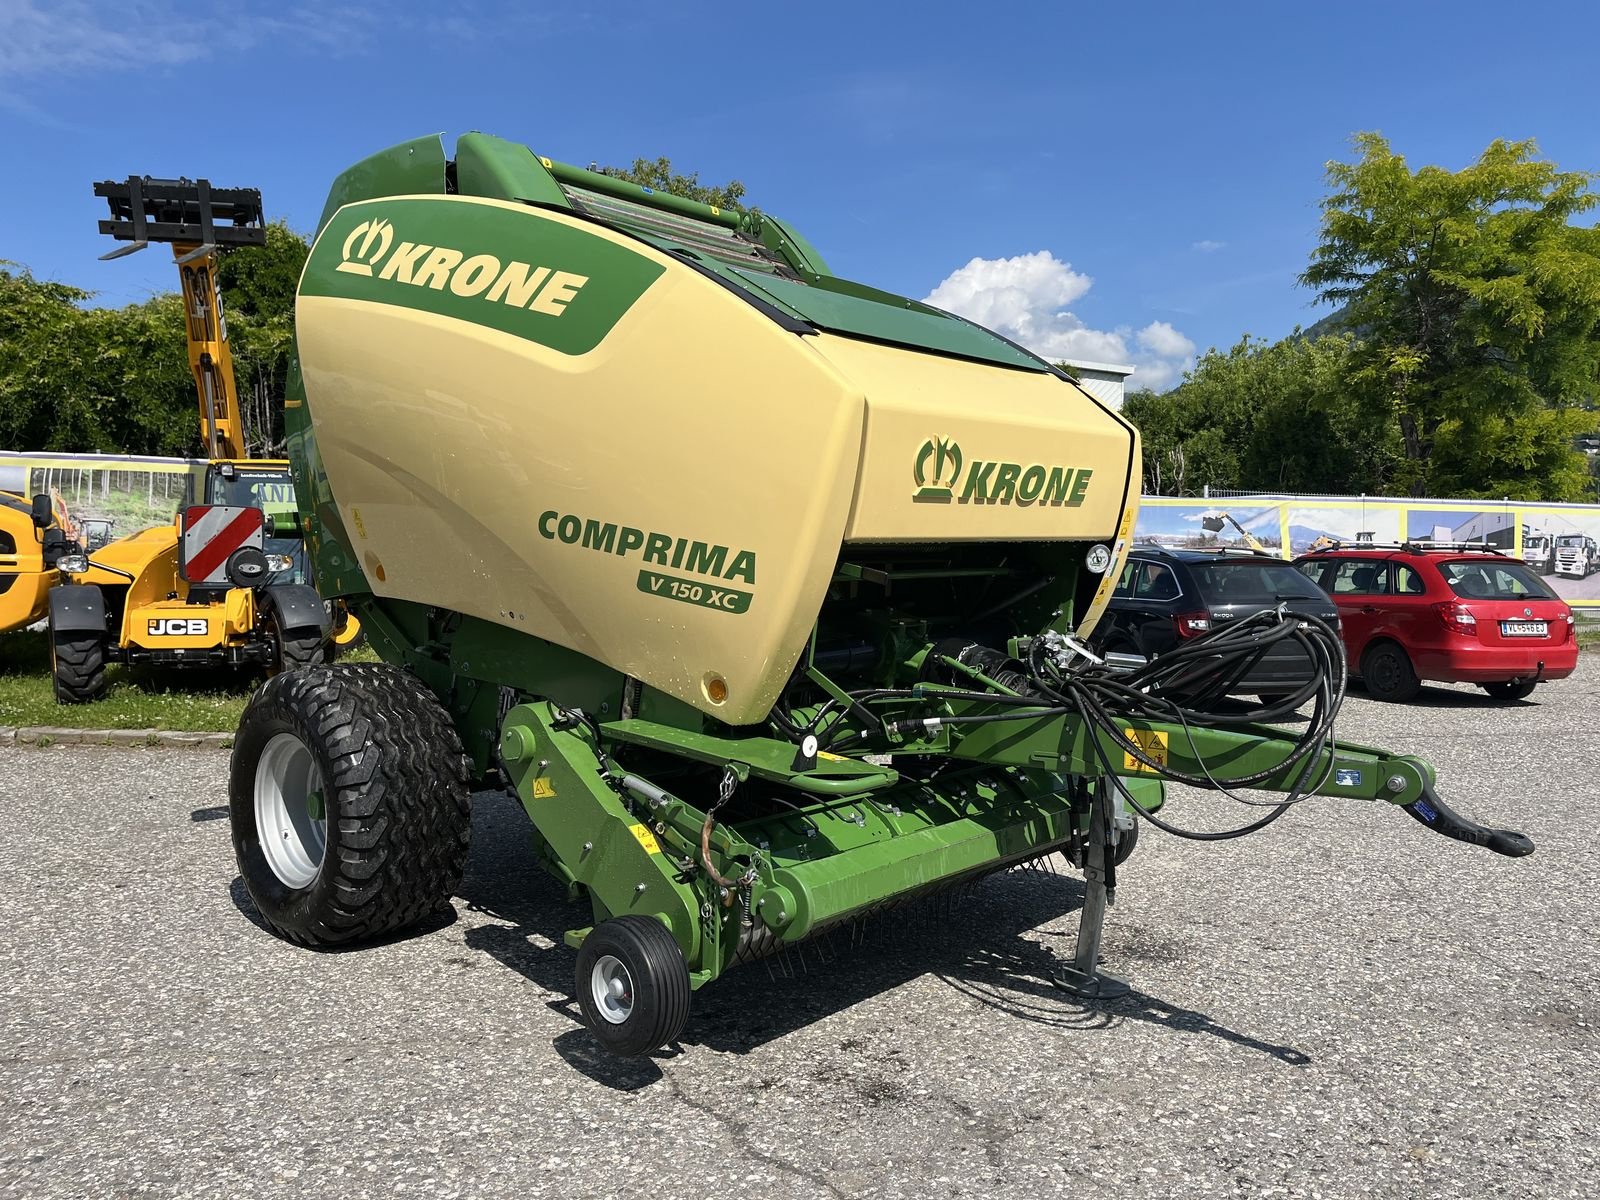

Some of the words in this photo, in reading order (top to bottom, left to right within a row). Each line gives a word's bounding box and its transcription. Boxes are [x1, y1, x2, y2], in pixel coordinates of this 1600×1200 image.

[378, 241, 589, 317] KRONE
[959, 461, 1093, 505] KRONE
[538, 510, 756, 585] COMPRIMA
[649, 576, 665, 591] V
[670, 581, 703, 601] 150
[706, 590, 739, 609] XC
[149, 619, 208, 635] JCB
